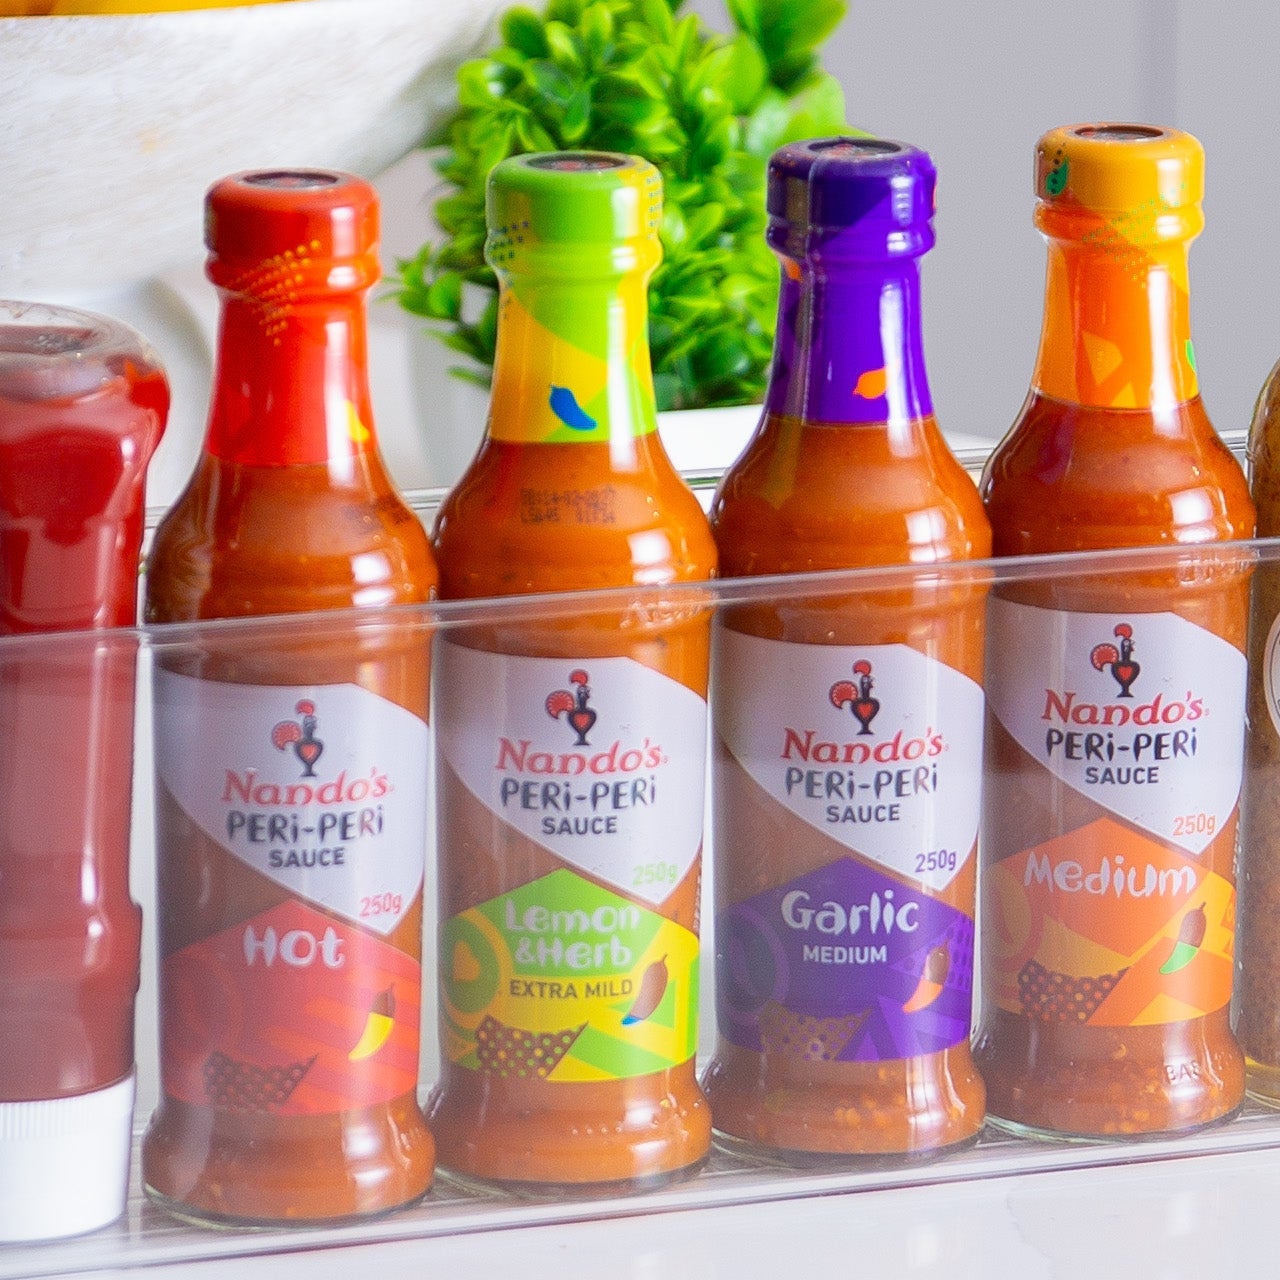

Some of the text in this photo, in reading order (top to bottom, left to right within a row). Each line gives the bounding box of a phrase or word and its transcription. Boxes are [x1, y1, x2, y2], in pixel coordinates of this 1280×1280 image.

[1042, 688, 1205, 727] Nando's
[495, 736, 665, 776] Nando's
[780, 726, 945, 765] Nando's
[220, 765, 391, 807] Nando's
[1085, 766, 1160, 785] SAUCE
[541, 815, 618, 837] SAUCE
[825, 803, 901, 824] SAUCE
[1173, 812, 1217, 838] 250g
[268, 846, 346, 869] SAUCE
[914, 847, 958, 874] 250g
[632, 861, 679, 887] 250g
[1023, 850, 1198, 899] Medium
[359, 891, 403, 919] 250g
[503, 897, 642, 933] Lemon
[780, 888, 920, 937] Garlic
[802, 944, 888, 965] MEDIUM
[508, 978, 634, 1000] EXTRA MILD
